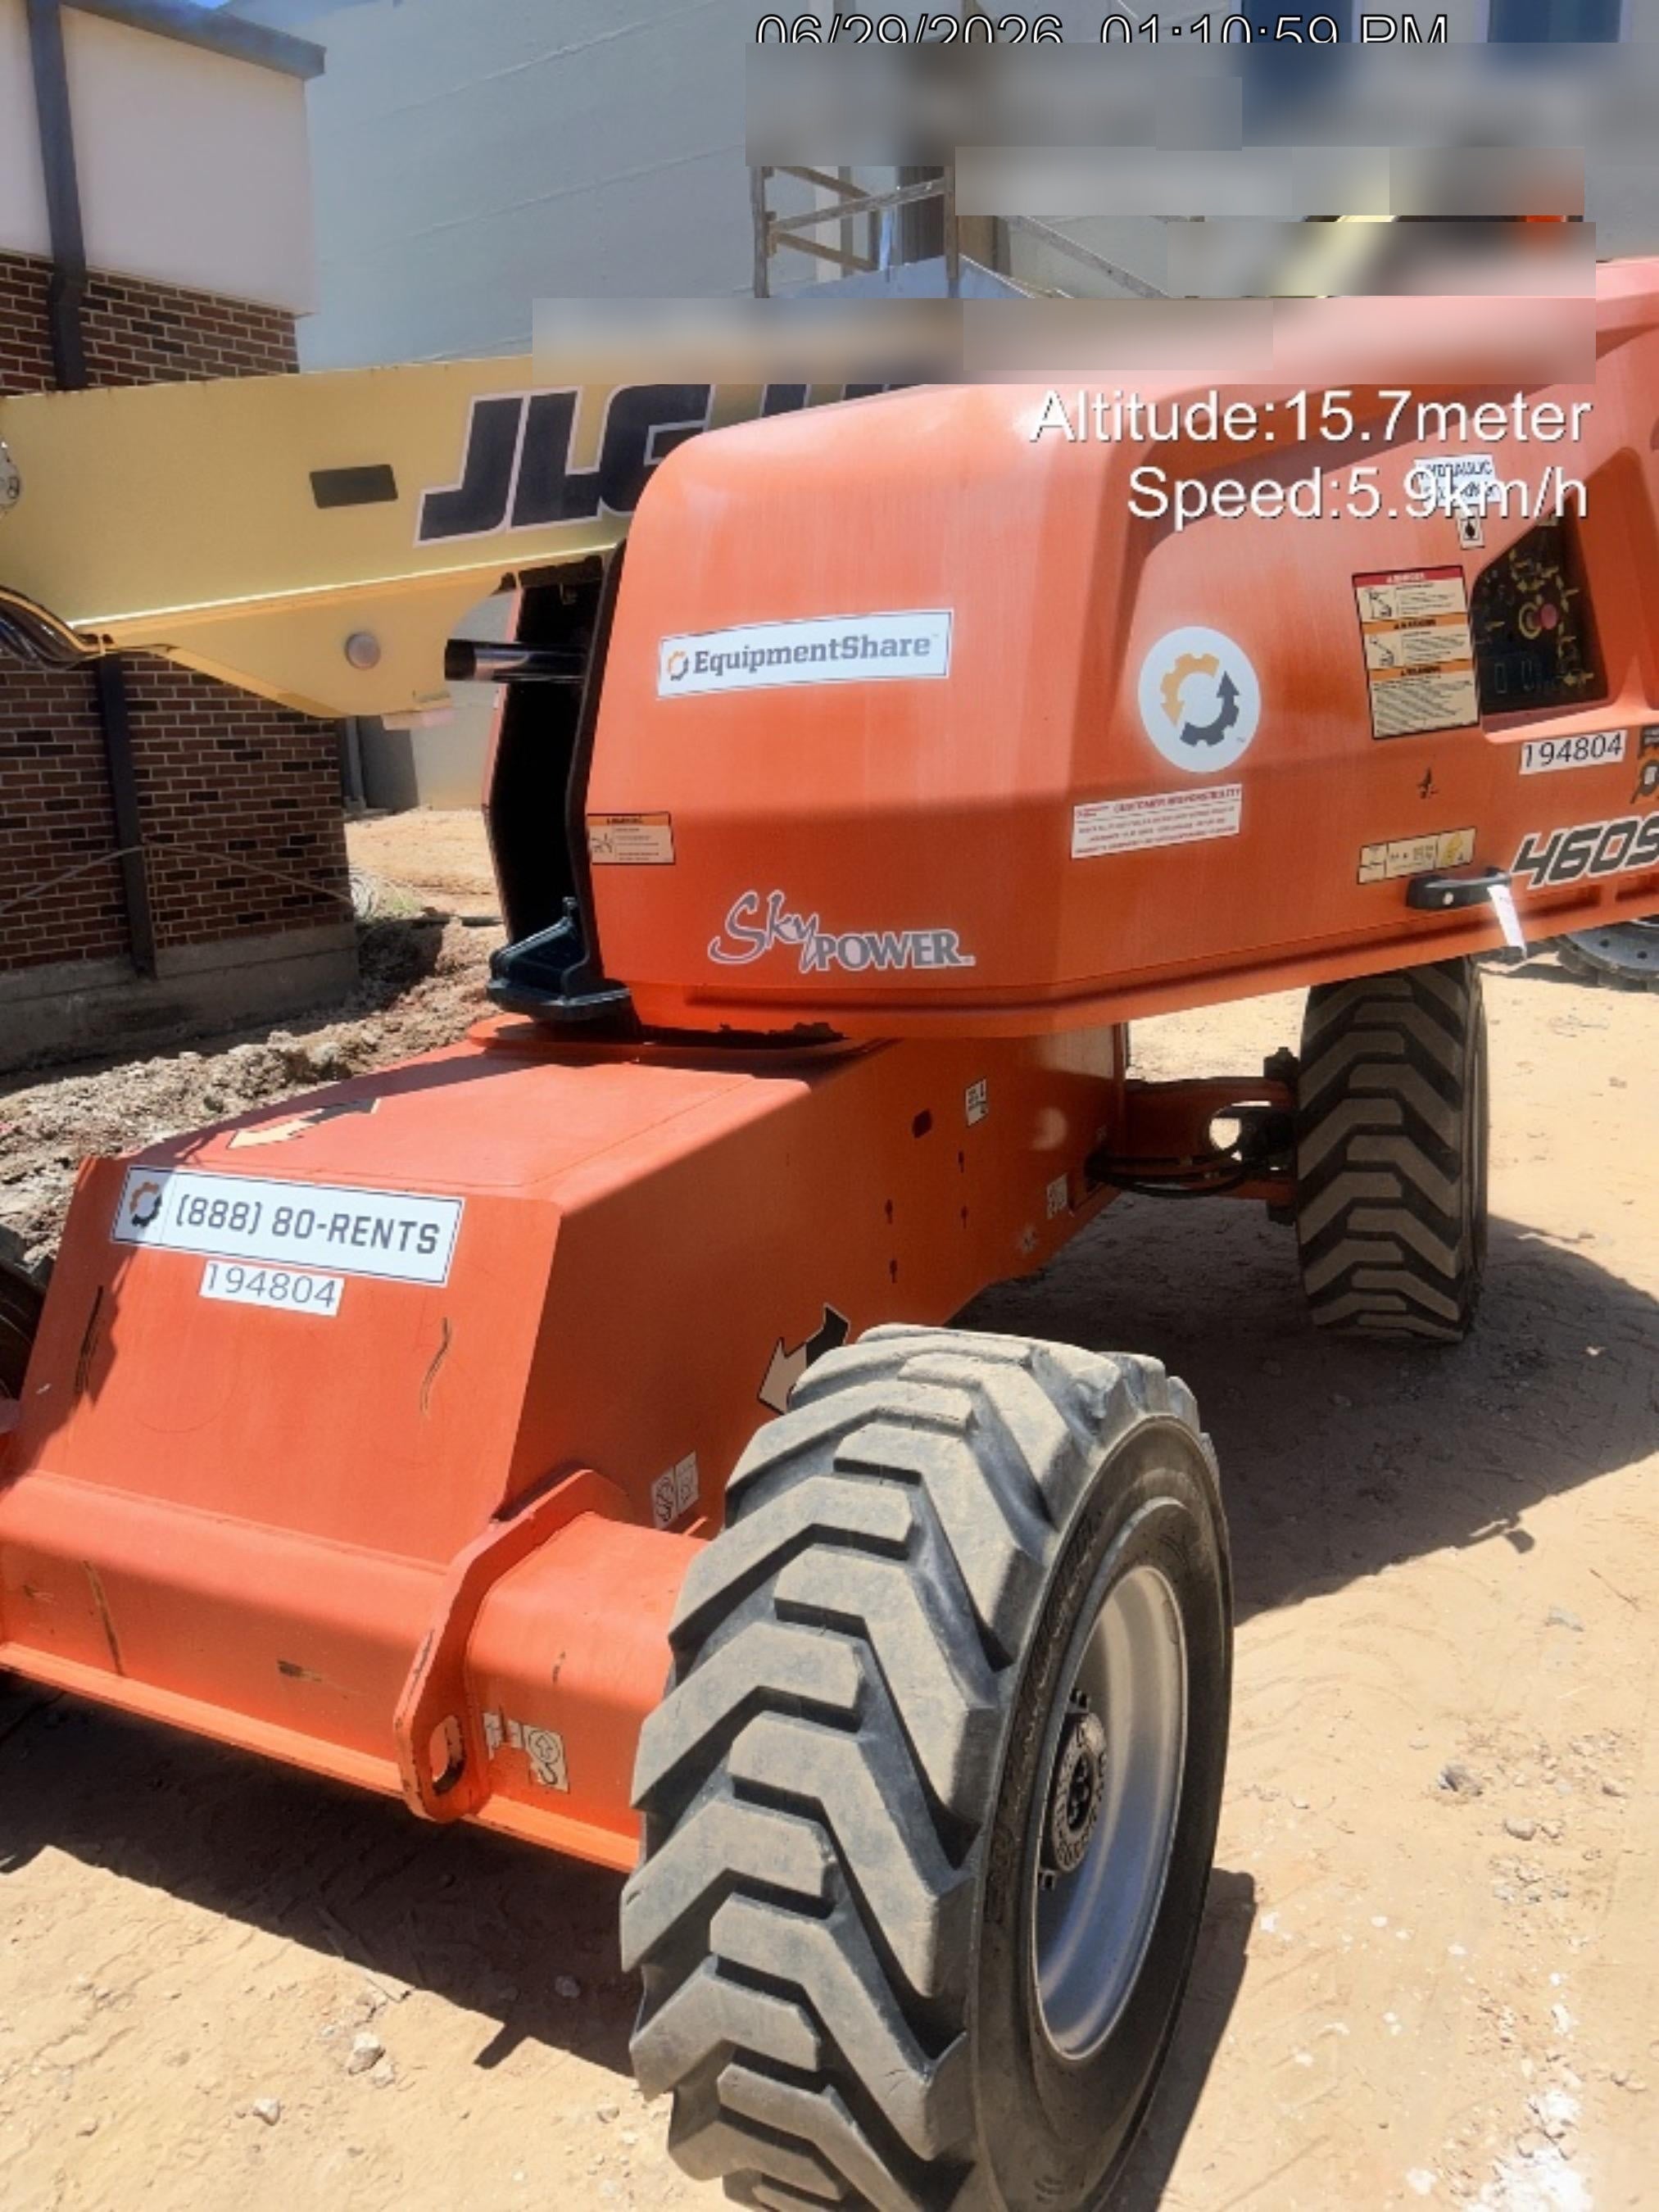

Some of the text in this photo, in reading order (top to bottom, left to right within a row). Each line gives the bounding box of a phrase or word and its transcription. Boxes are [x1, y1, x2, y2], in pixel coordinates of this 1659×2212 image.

[692, 634, 931, 676] EquipmentShare
[1525, 732, 1622, 767] 194804
[176, 1194, 441, 1254] (888) 80-RENTS
[208, 1264, 337, 1308] 194804
